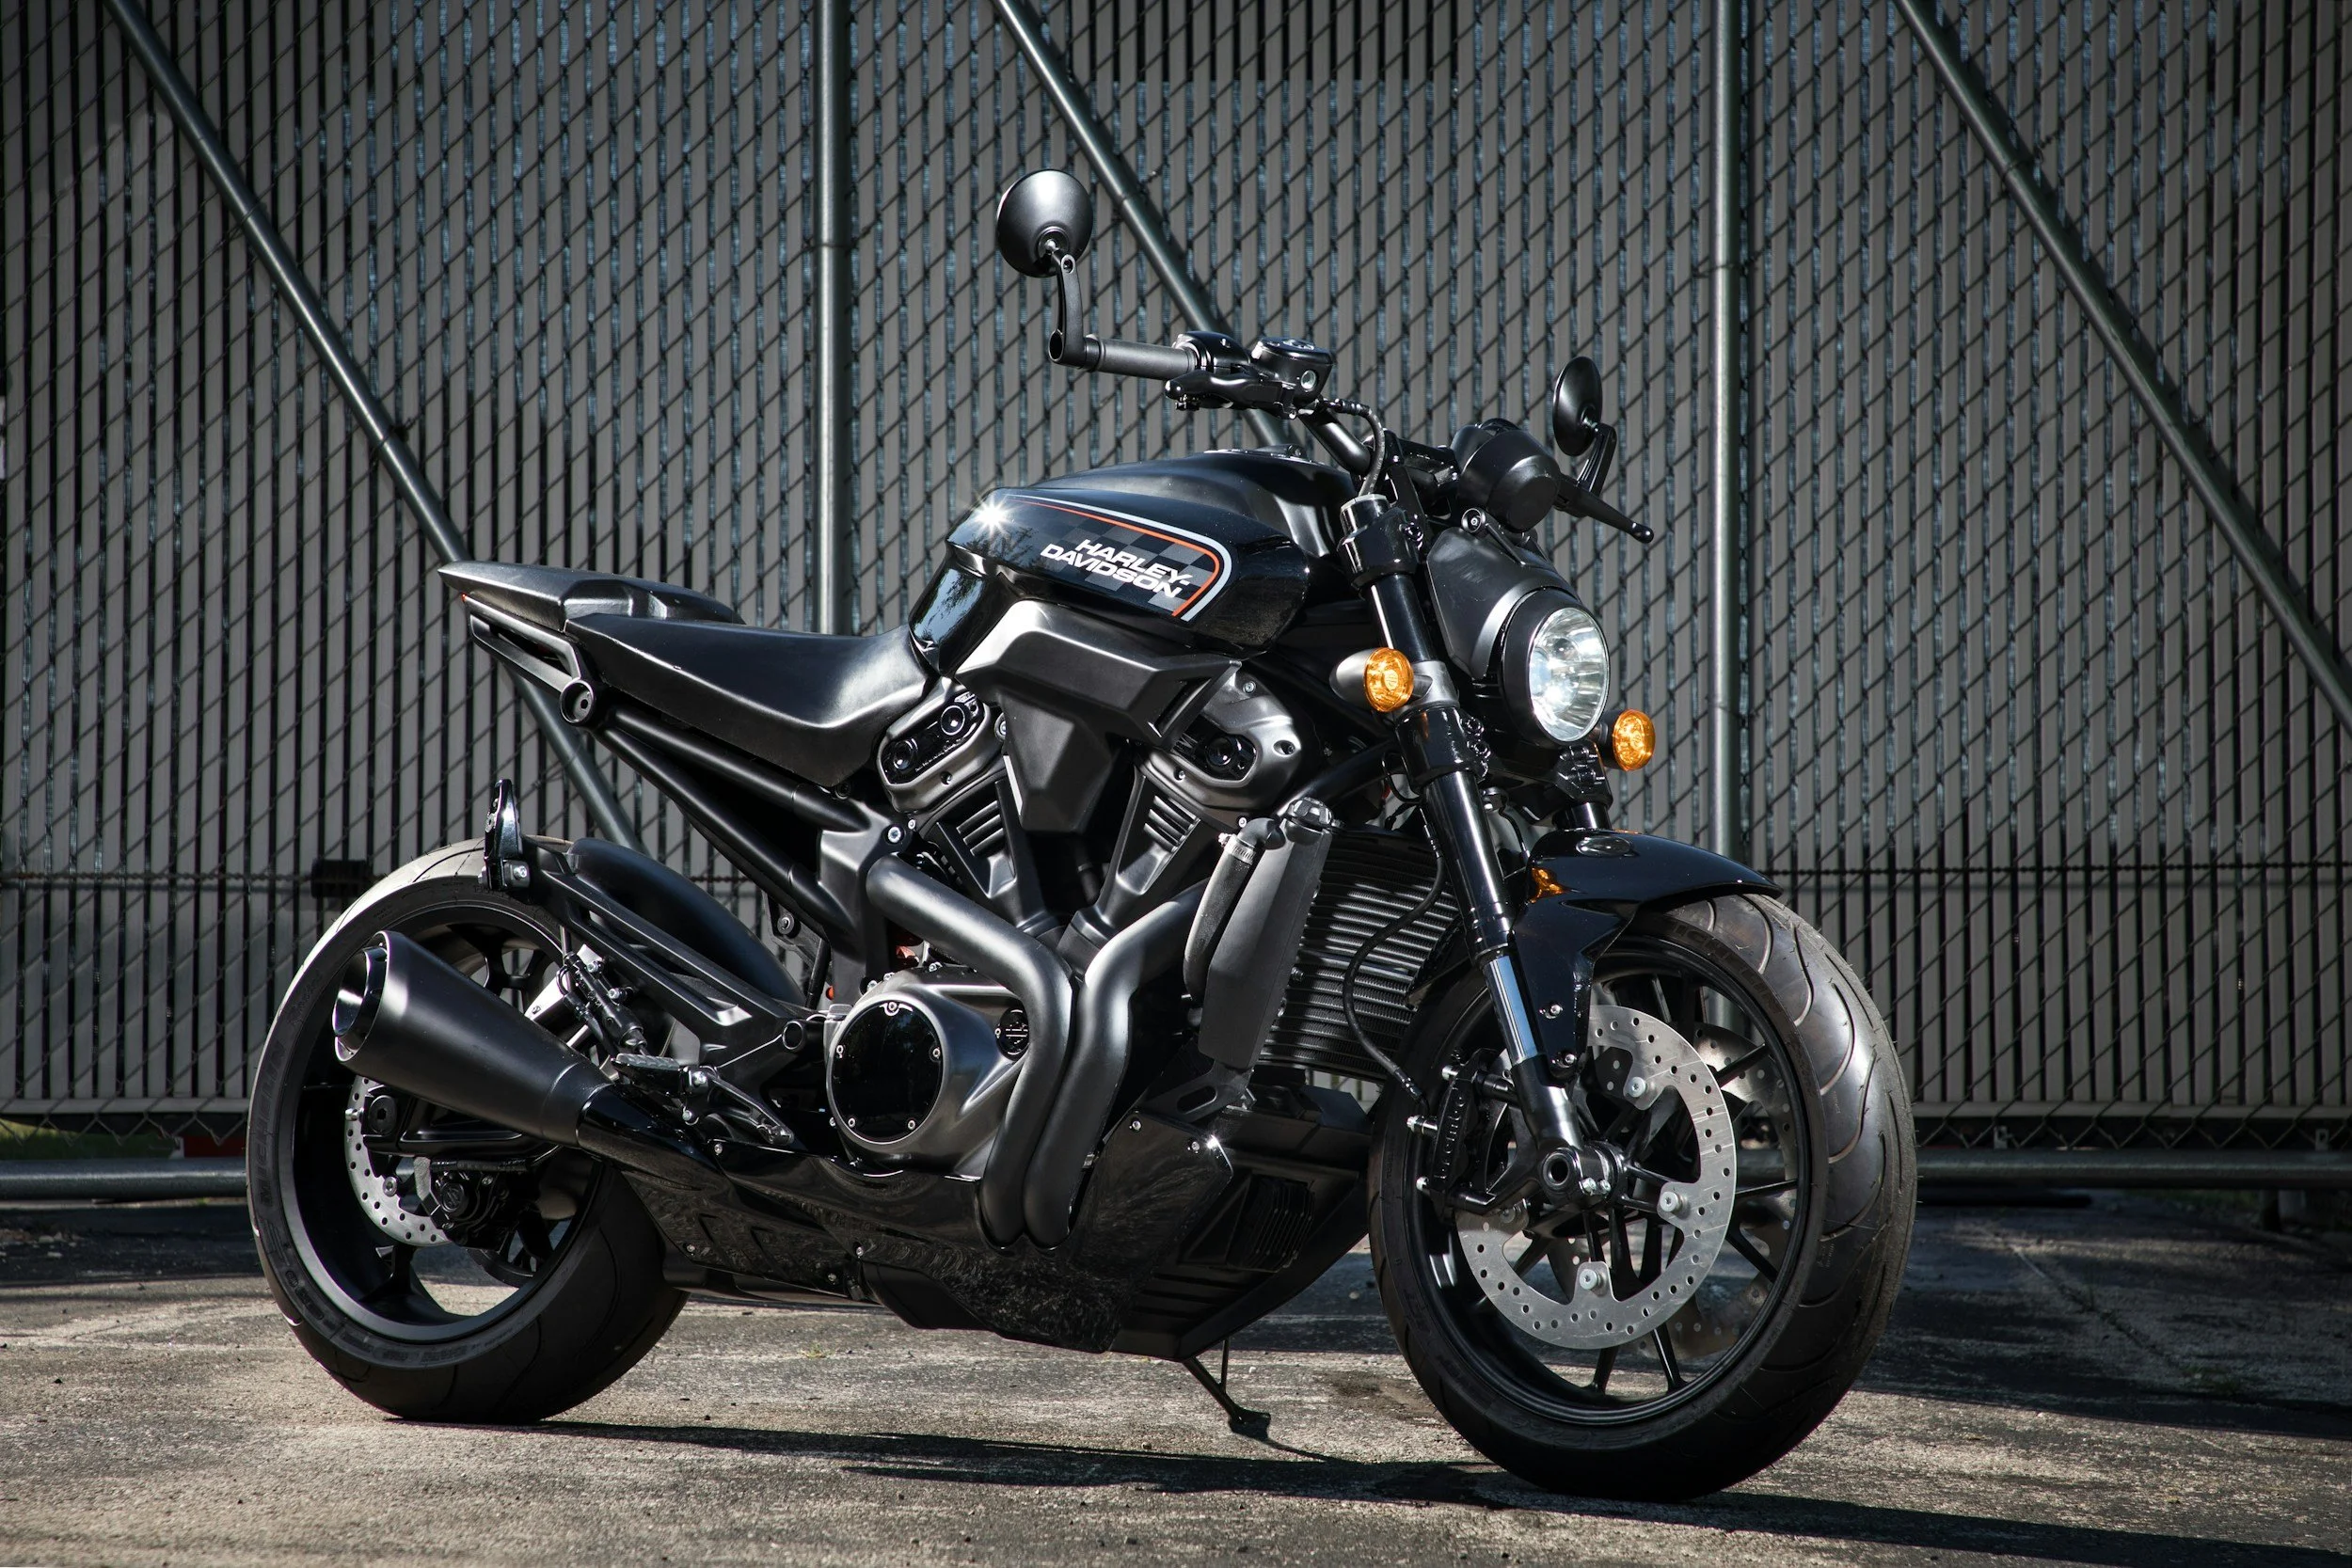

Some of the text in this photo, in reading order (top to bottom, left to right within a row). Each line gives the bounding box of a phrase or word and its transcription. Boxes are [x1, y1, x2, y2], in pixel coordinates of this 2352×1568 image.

[1041, 544, 1183, 598] DAVIDSON
[1075, 539, 1193, 585] HARLEY-
[258, 1039, 286, 1209] MICHELIN
